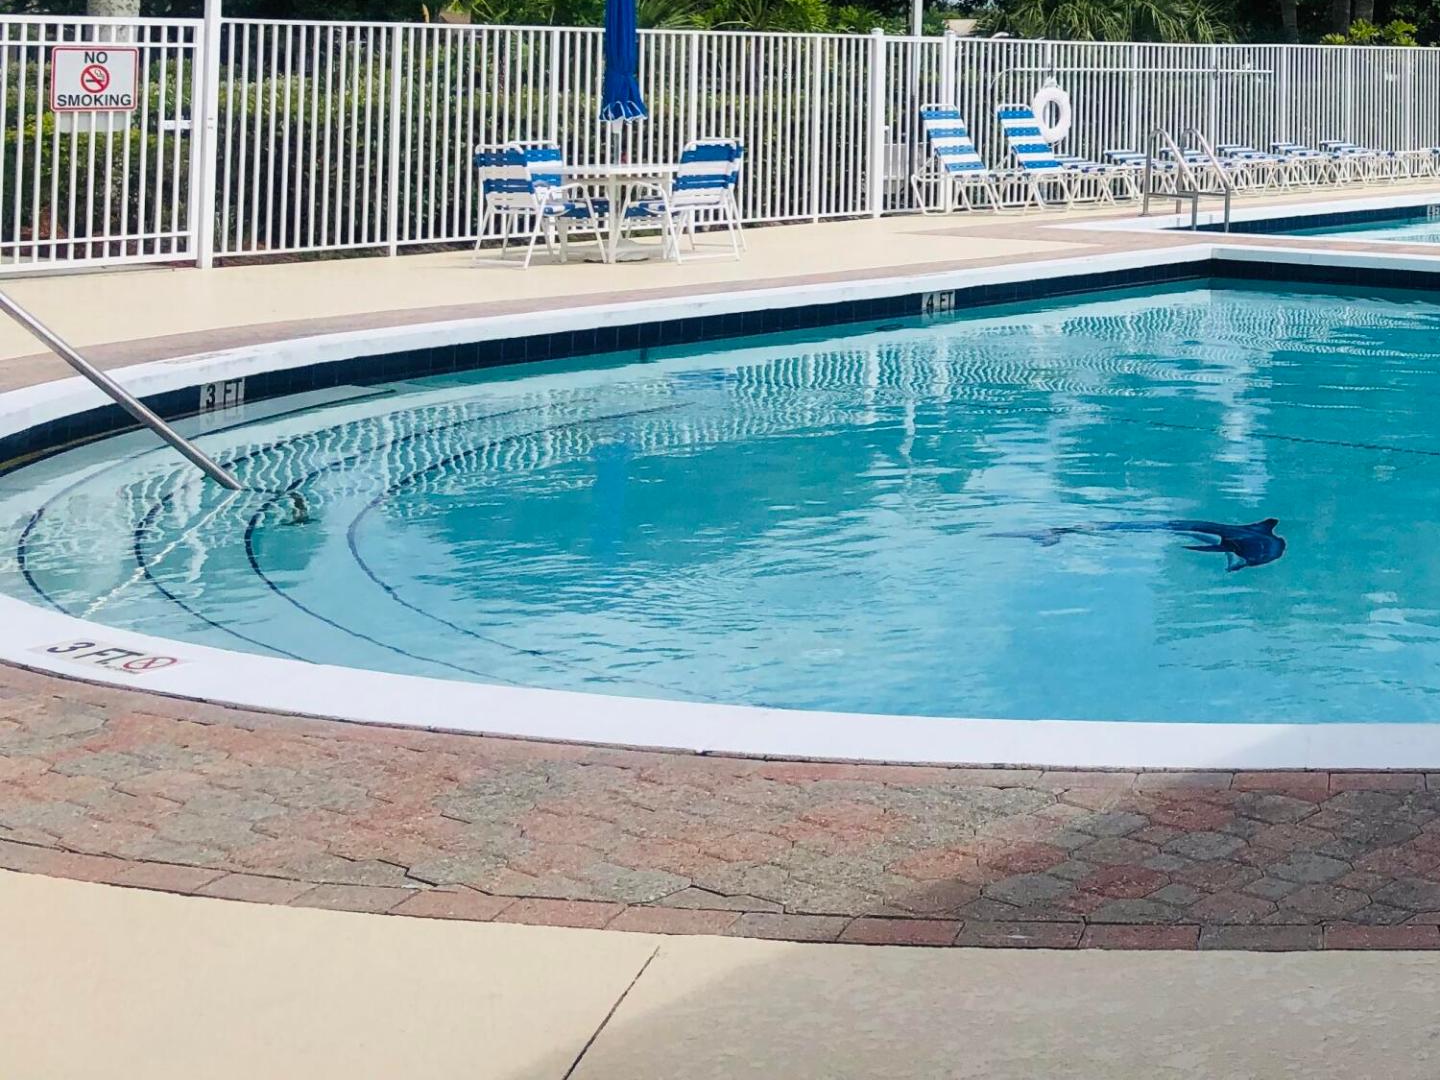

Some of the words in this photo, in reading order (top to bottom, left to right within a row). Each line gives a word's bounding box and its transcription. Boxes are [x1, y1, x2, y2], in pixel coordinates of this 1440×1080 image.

[84, 51, 108, 64] NO
[56, 94, 132, 107] SMOKING
[926, 293, 934, 310] 4
[939, 291, 954, 311] FT
[206, 383, 216, 409] 3
[223, 380, 243, 409] FT
[47, 641, 96, 653] 3
